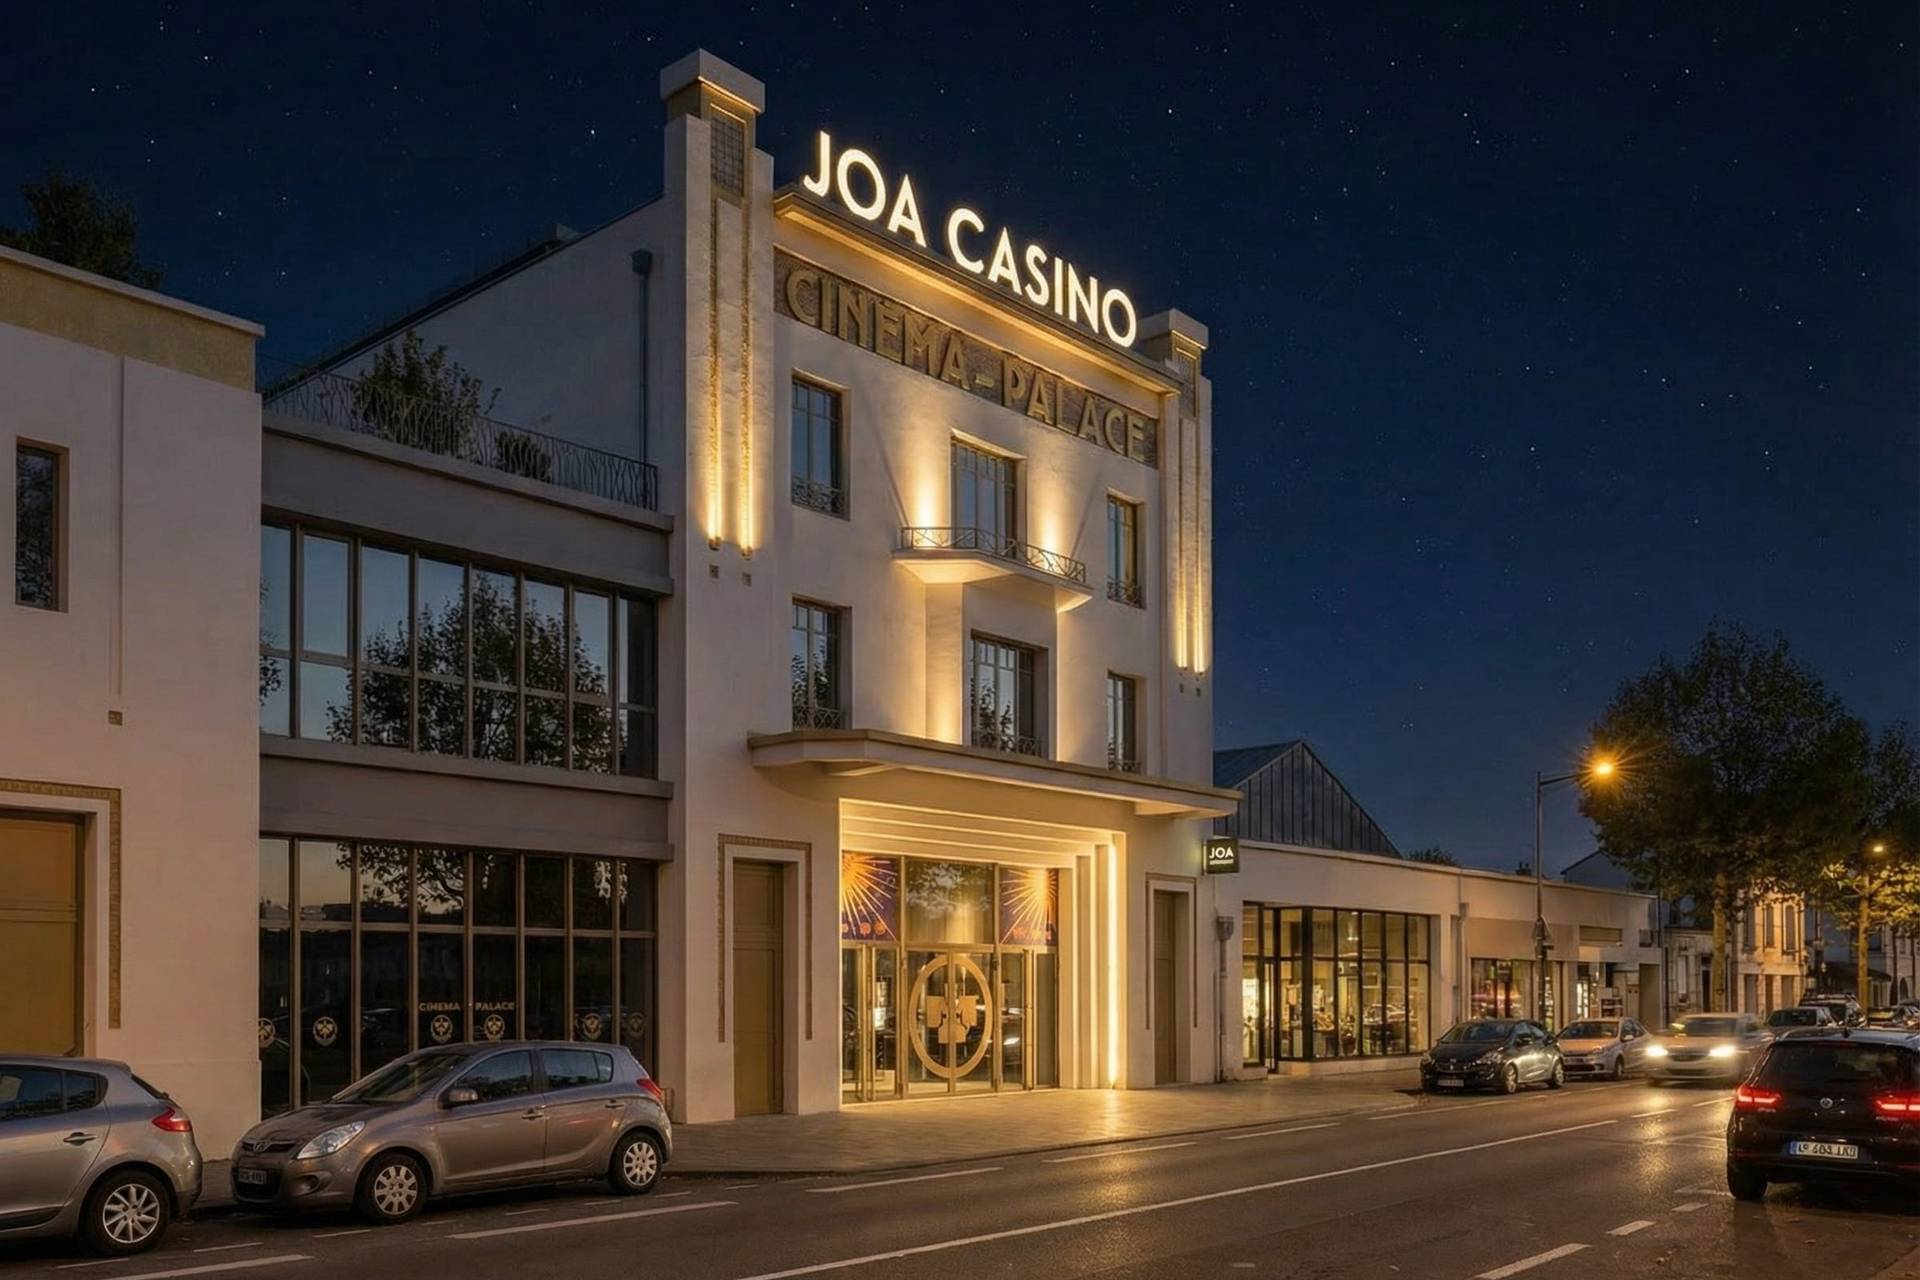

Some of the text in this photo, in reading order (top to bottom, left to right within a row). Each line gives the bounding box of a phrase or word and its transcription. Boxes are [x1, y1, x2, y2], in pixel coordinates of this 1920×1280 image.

[803, 130, 1137, 348] JOA CASINO
[1209, 846, 1234, 859] JOA
[475, 1001, 515, 1011] PALACE
